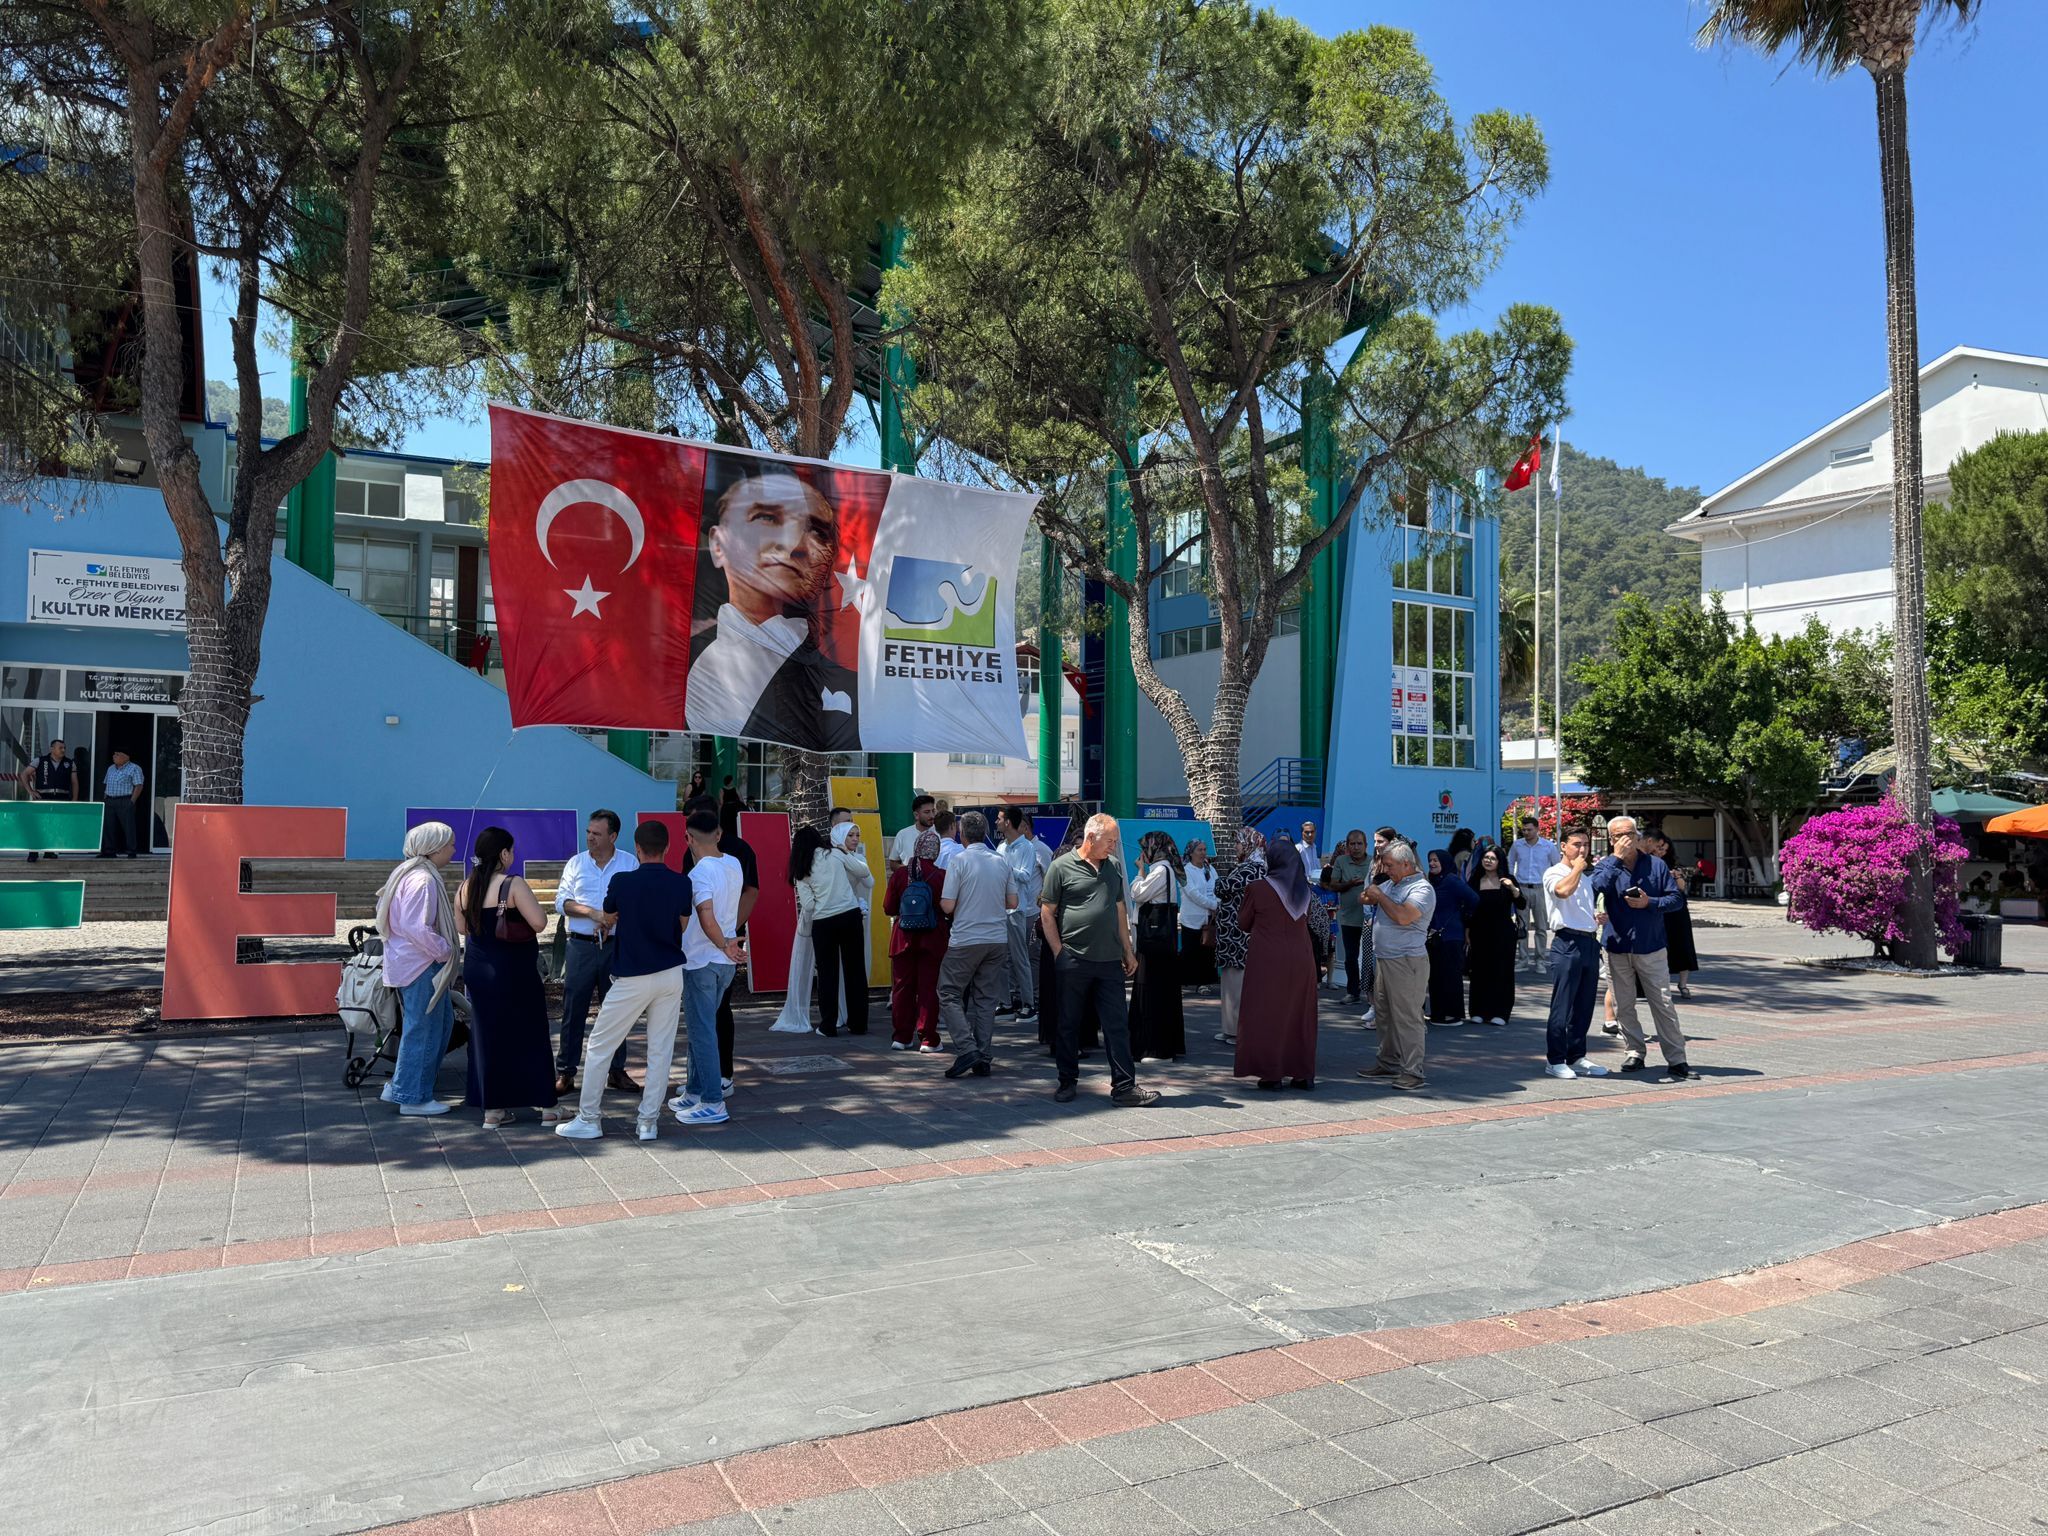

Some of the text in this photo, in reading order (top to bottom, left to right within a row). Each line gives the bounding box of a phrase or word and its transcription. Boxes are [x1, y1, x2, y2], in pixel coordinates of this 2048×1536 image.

[55, 577, 74, 586] T.C.
[114, 589, 166, 606] Olgun
[114, 605, 186, 621] MERKEZ
[885, 645, 1002, 669] FETHİYE
[885, 666, 1002, 683] BELEDİYESİ
[1432, 810, 1459, 823] FETHİYE
